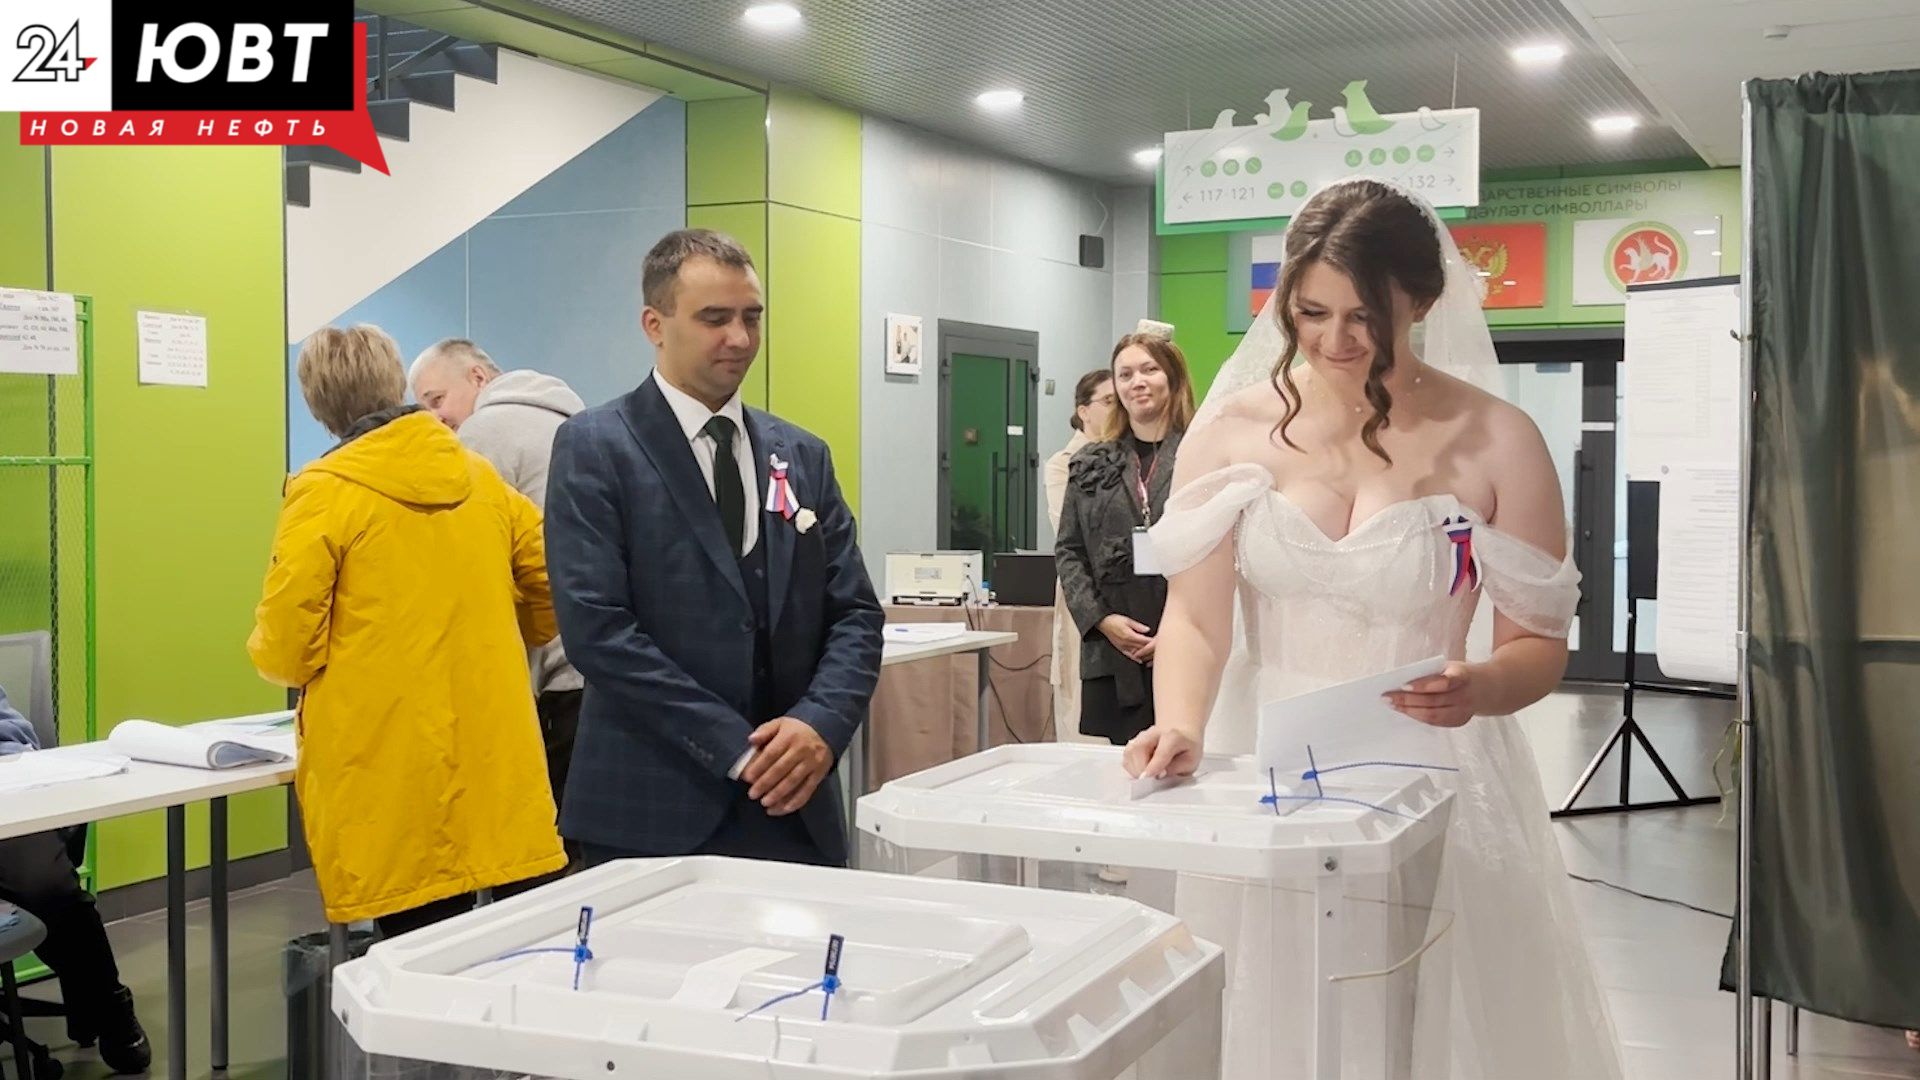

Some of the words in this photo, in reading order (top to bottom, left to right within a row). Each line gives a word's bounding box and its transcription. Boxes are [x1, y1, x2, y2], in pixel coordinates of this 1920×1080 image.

[1408, 174, 1436, 189] 132
[1596, 180, 1682, 196] СИМВОЛЫ
[1533, 200, 1648, 216] СИМВОЛЛАРЫ
